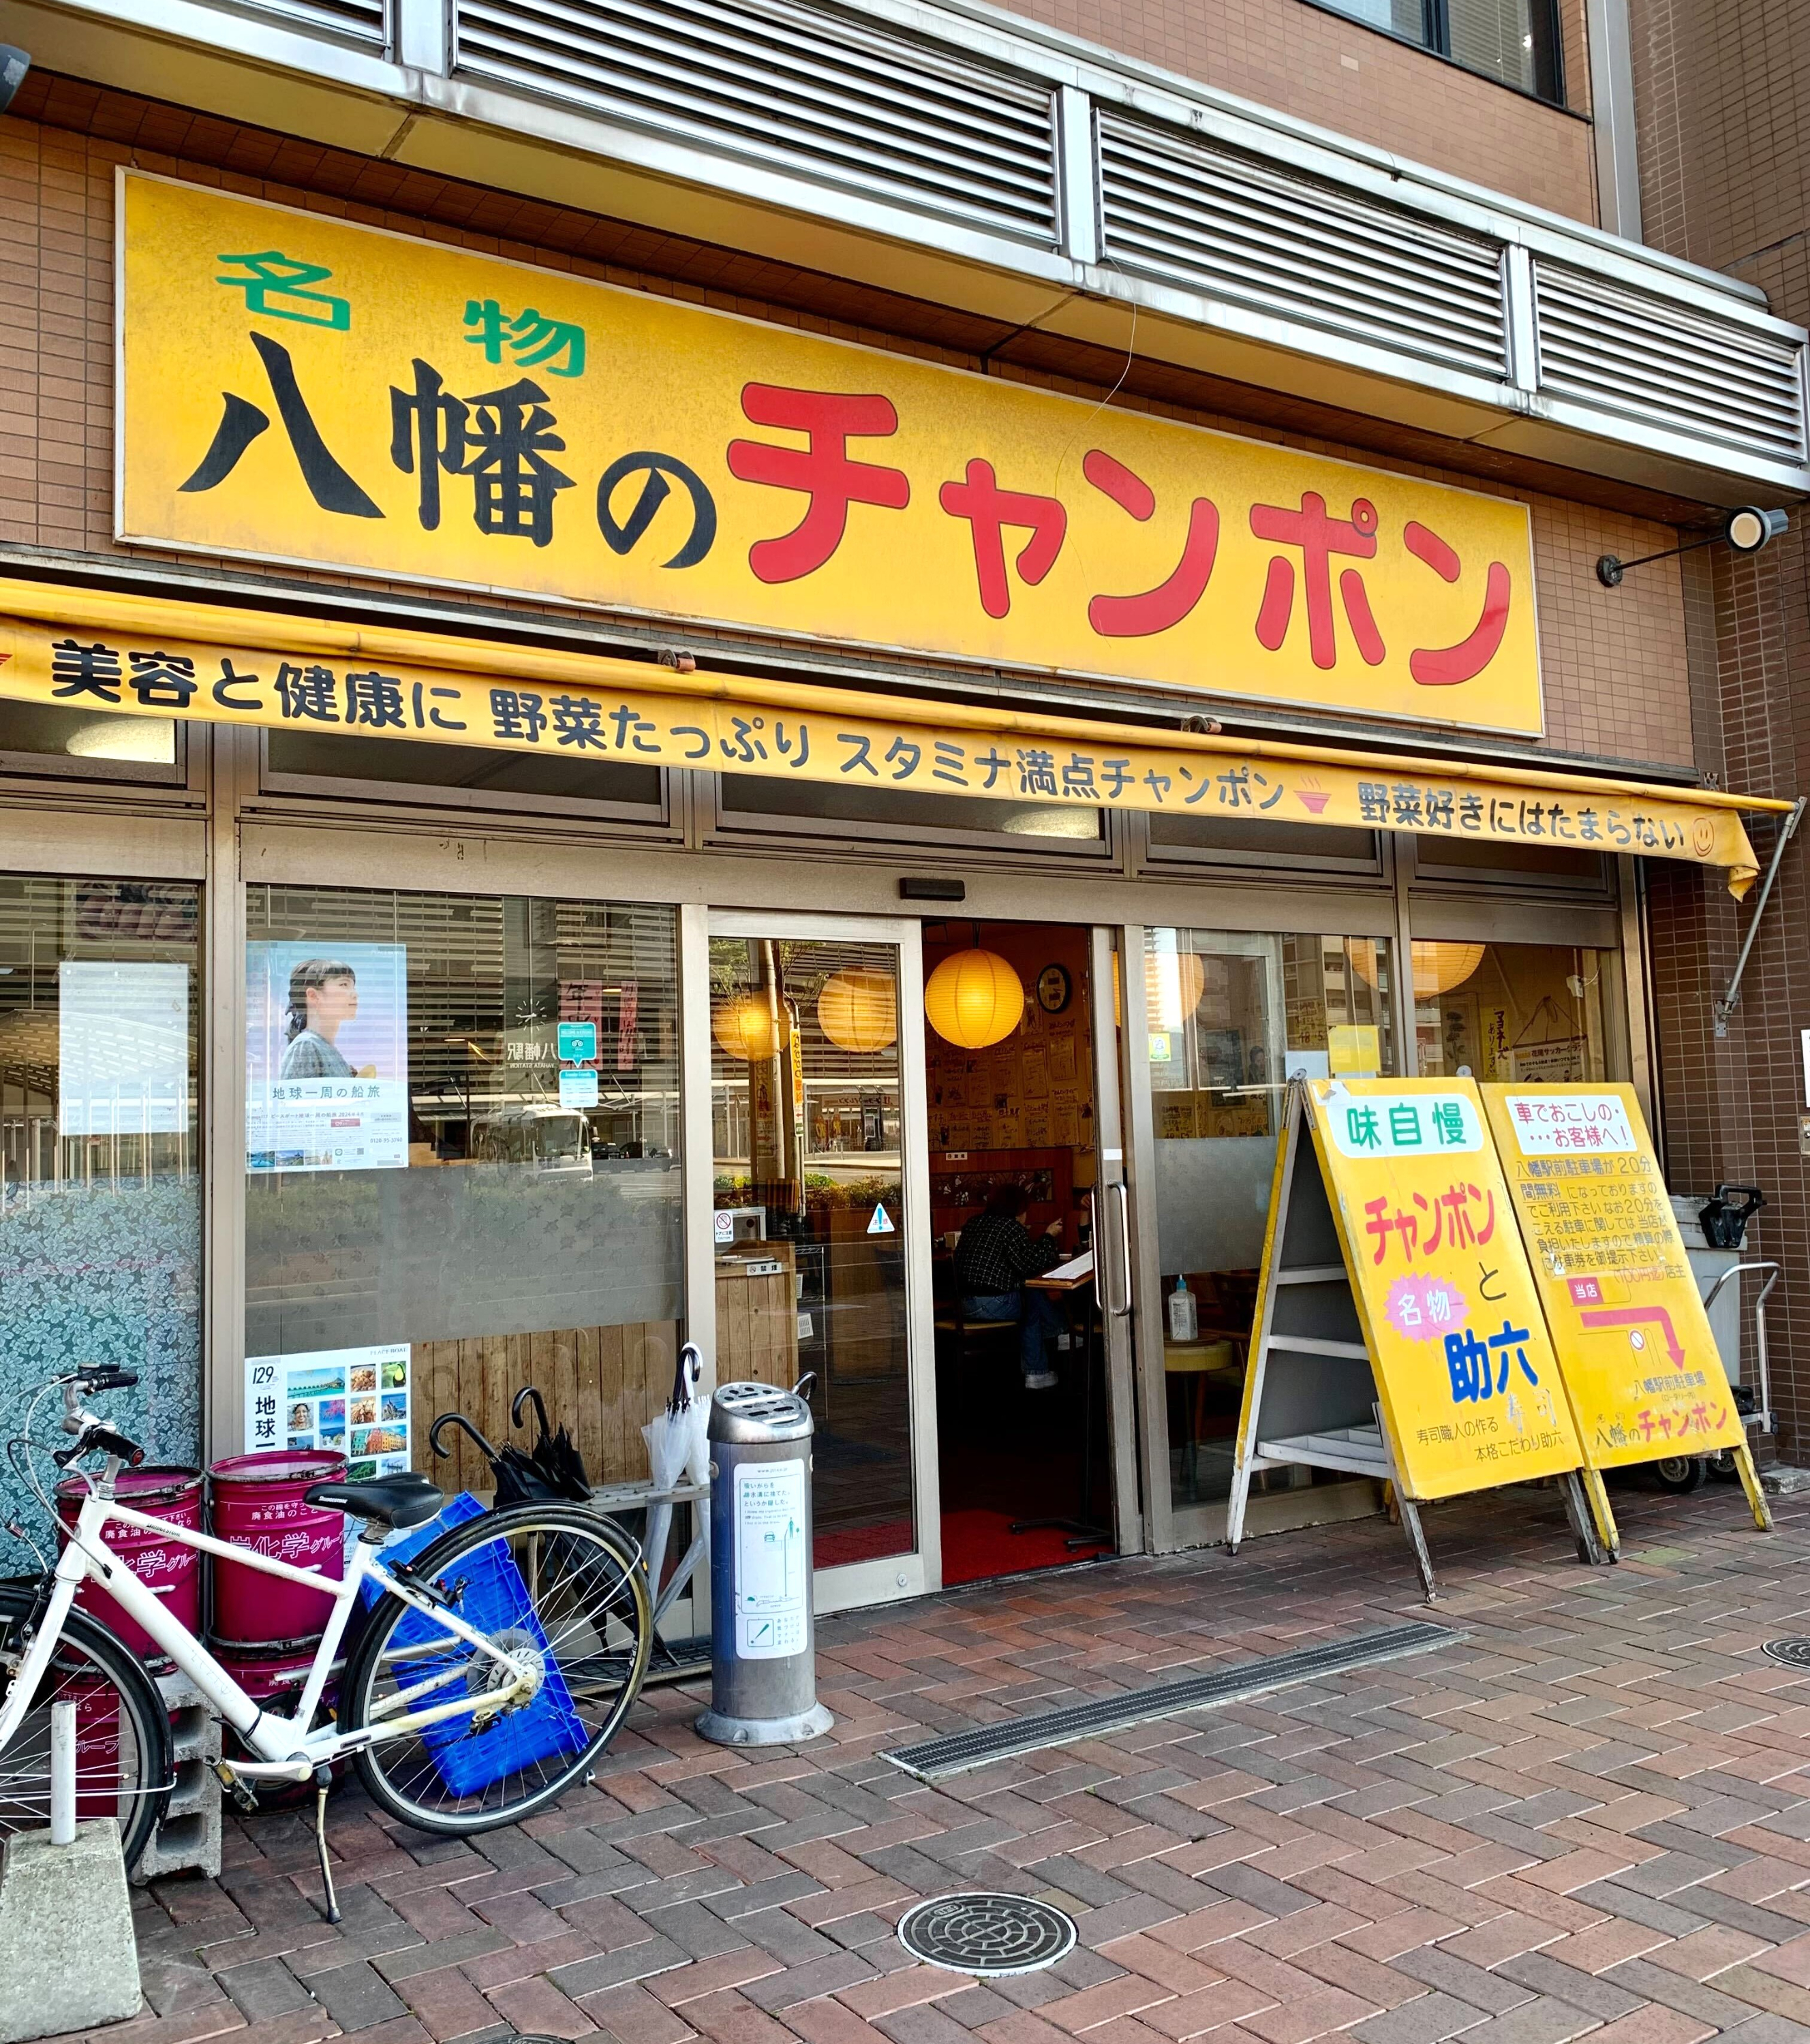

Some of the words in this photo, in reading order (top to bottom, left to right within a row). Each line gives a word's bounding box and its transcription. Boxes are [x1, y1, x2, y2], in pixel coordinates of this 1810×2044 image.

[215, 249, 586, 378] 名物
[177, 331, 1511, 686] 八幡のチャンポン
[51, 640, 467, 730] 美容と健康に
[489, 688, 809, 768] 野菜たっぷり
[837, 733, 1283, 811] スタミナ満点チャンポン
[1358, 781, 1685, 850] 野菜好きにはたまらない
[273, 1085, 380, 1100] 地球一周の船旅
[1346, 1102, 1467, 1150] 味自慢
[1364, 1181, 1495, 1266] チャンポン
[1479, 1261, 1507, 1301] と
[1574, 1282, 1597, 1299] 当店
[1398, 1289, 1451, 1327] 名物
[253, 1366, 274, 1384] 129
[1443, 1320, 1539, 1404] 助六
[1633, 1370, 1706, 1395] 八幡駅前駐車場
[1416, 1416, 1499, 1446] 寿司職人の作る
[1474, 1429, 1565, 1462] 本格こだわり助六
